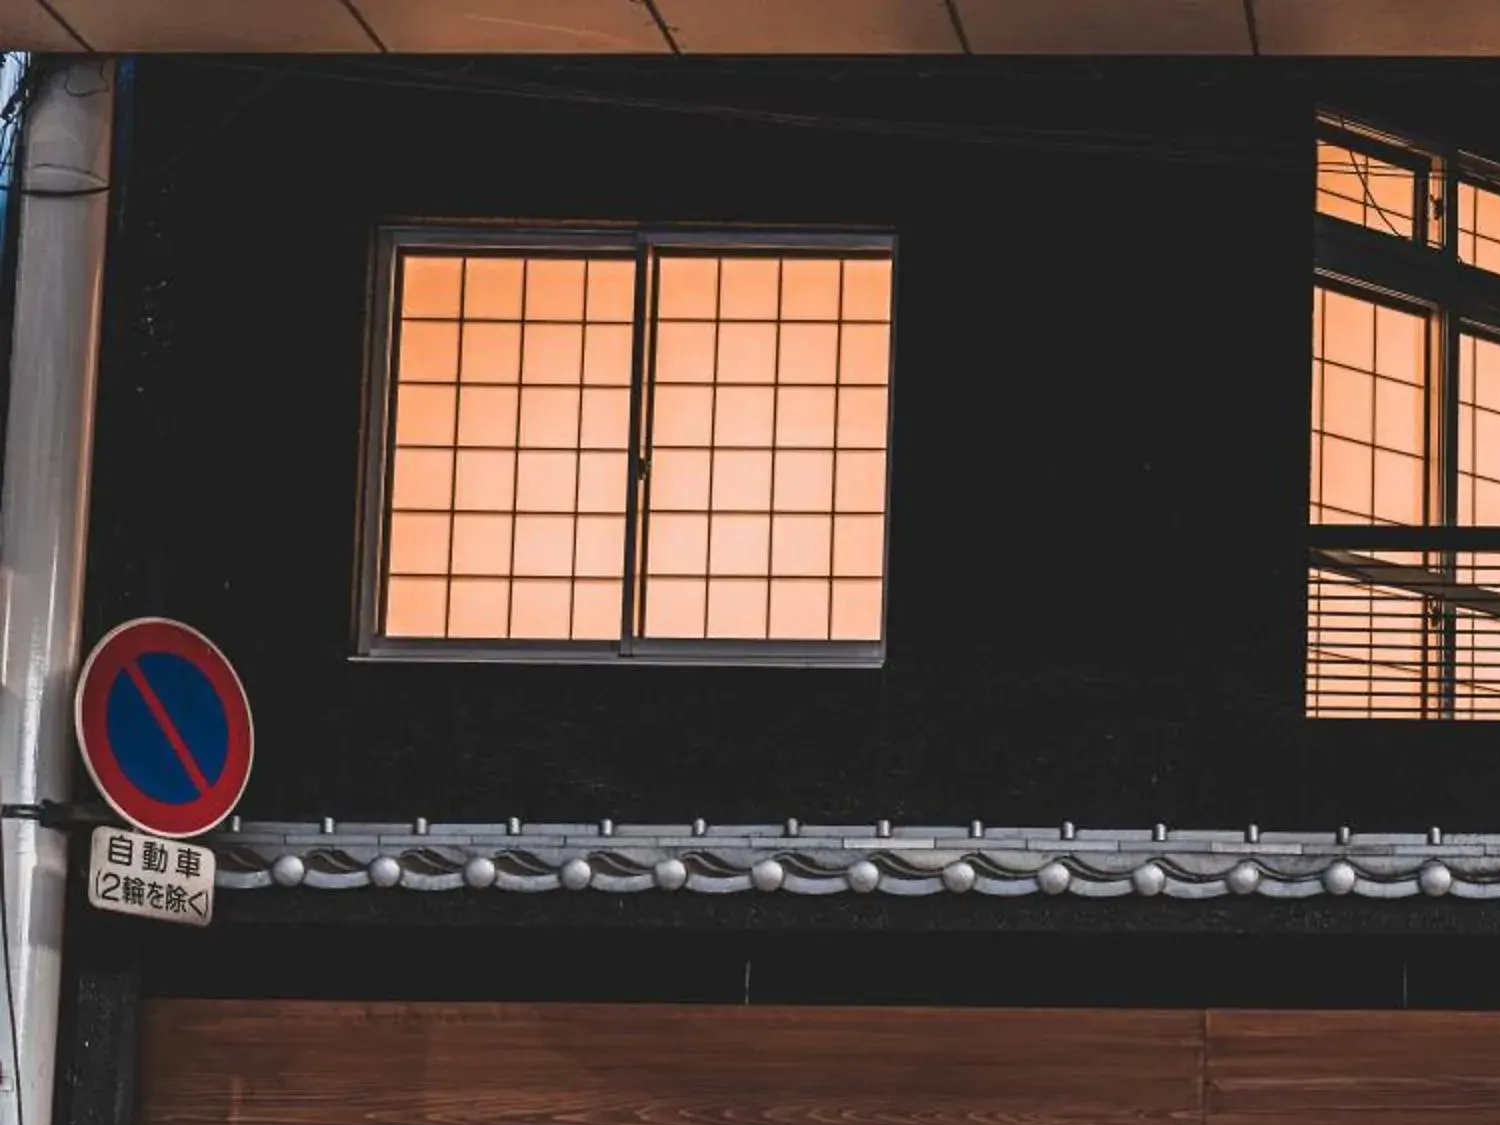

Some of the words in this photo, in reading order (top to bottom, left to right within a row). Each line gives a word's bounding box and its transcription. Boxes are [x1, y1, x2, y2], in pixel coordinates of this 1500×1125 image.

[107, 834, 203, 879] 自動車
[94, 869, 210, 917] (2輪を除く)
